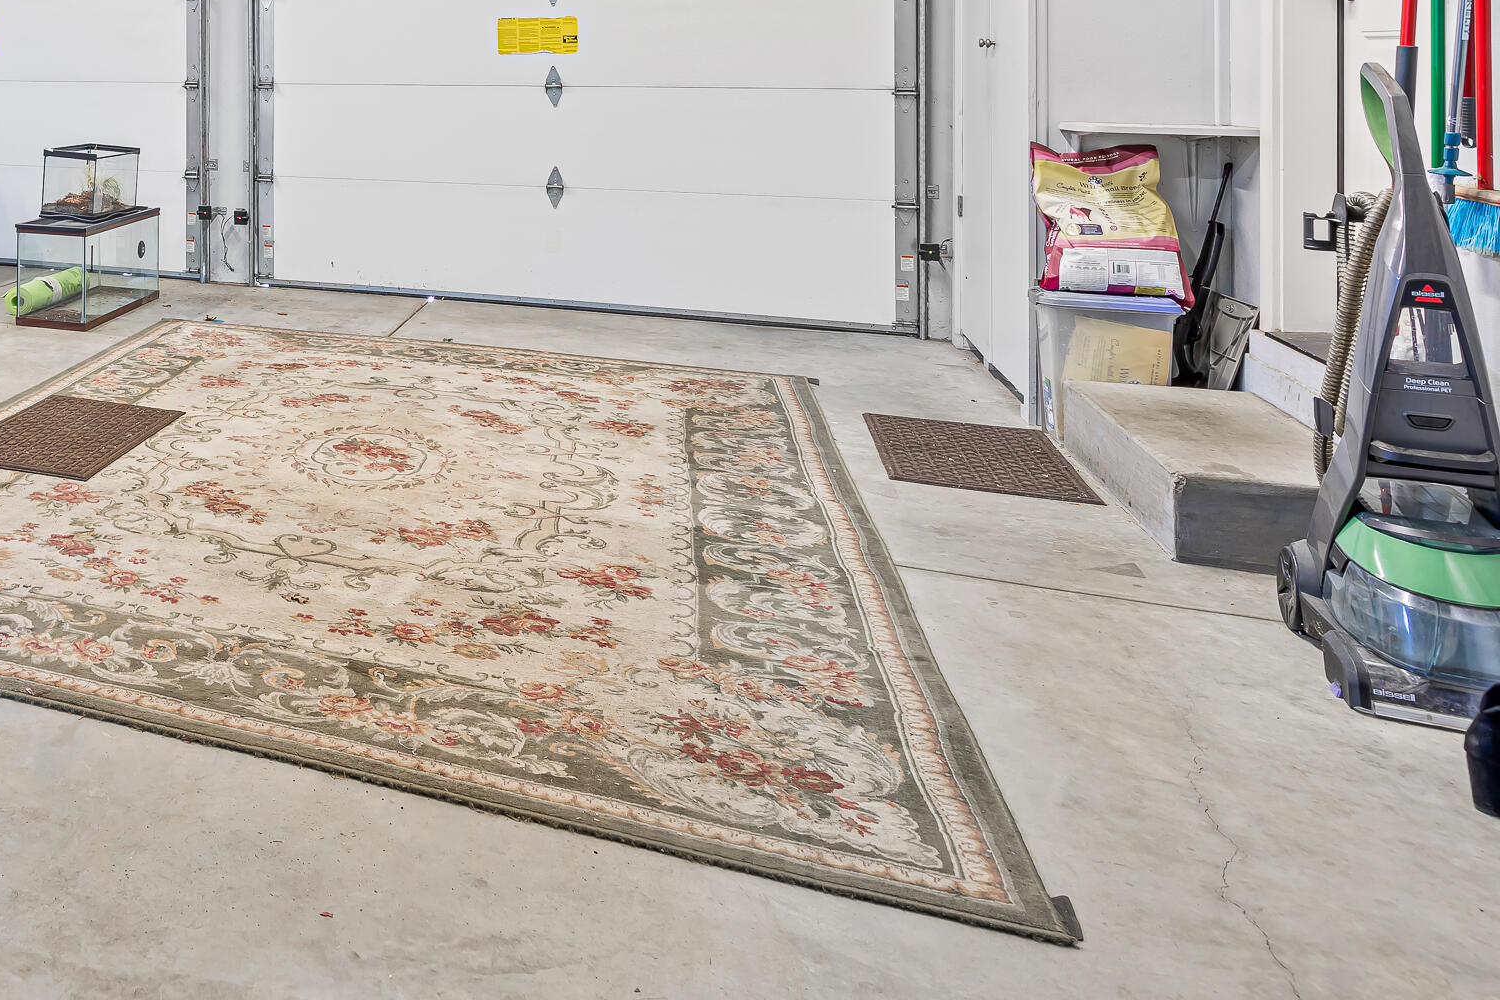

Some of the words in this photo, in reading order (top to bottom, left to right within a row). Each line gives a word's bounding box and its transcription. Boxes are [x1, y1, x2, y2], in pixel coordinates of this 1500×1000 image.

[1405, 377, 1426, 386] Deep
[1427, 379, 1450, 387] Clean
[1403, 384, 1440, 393] Professional
